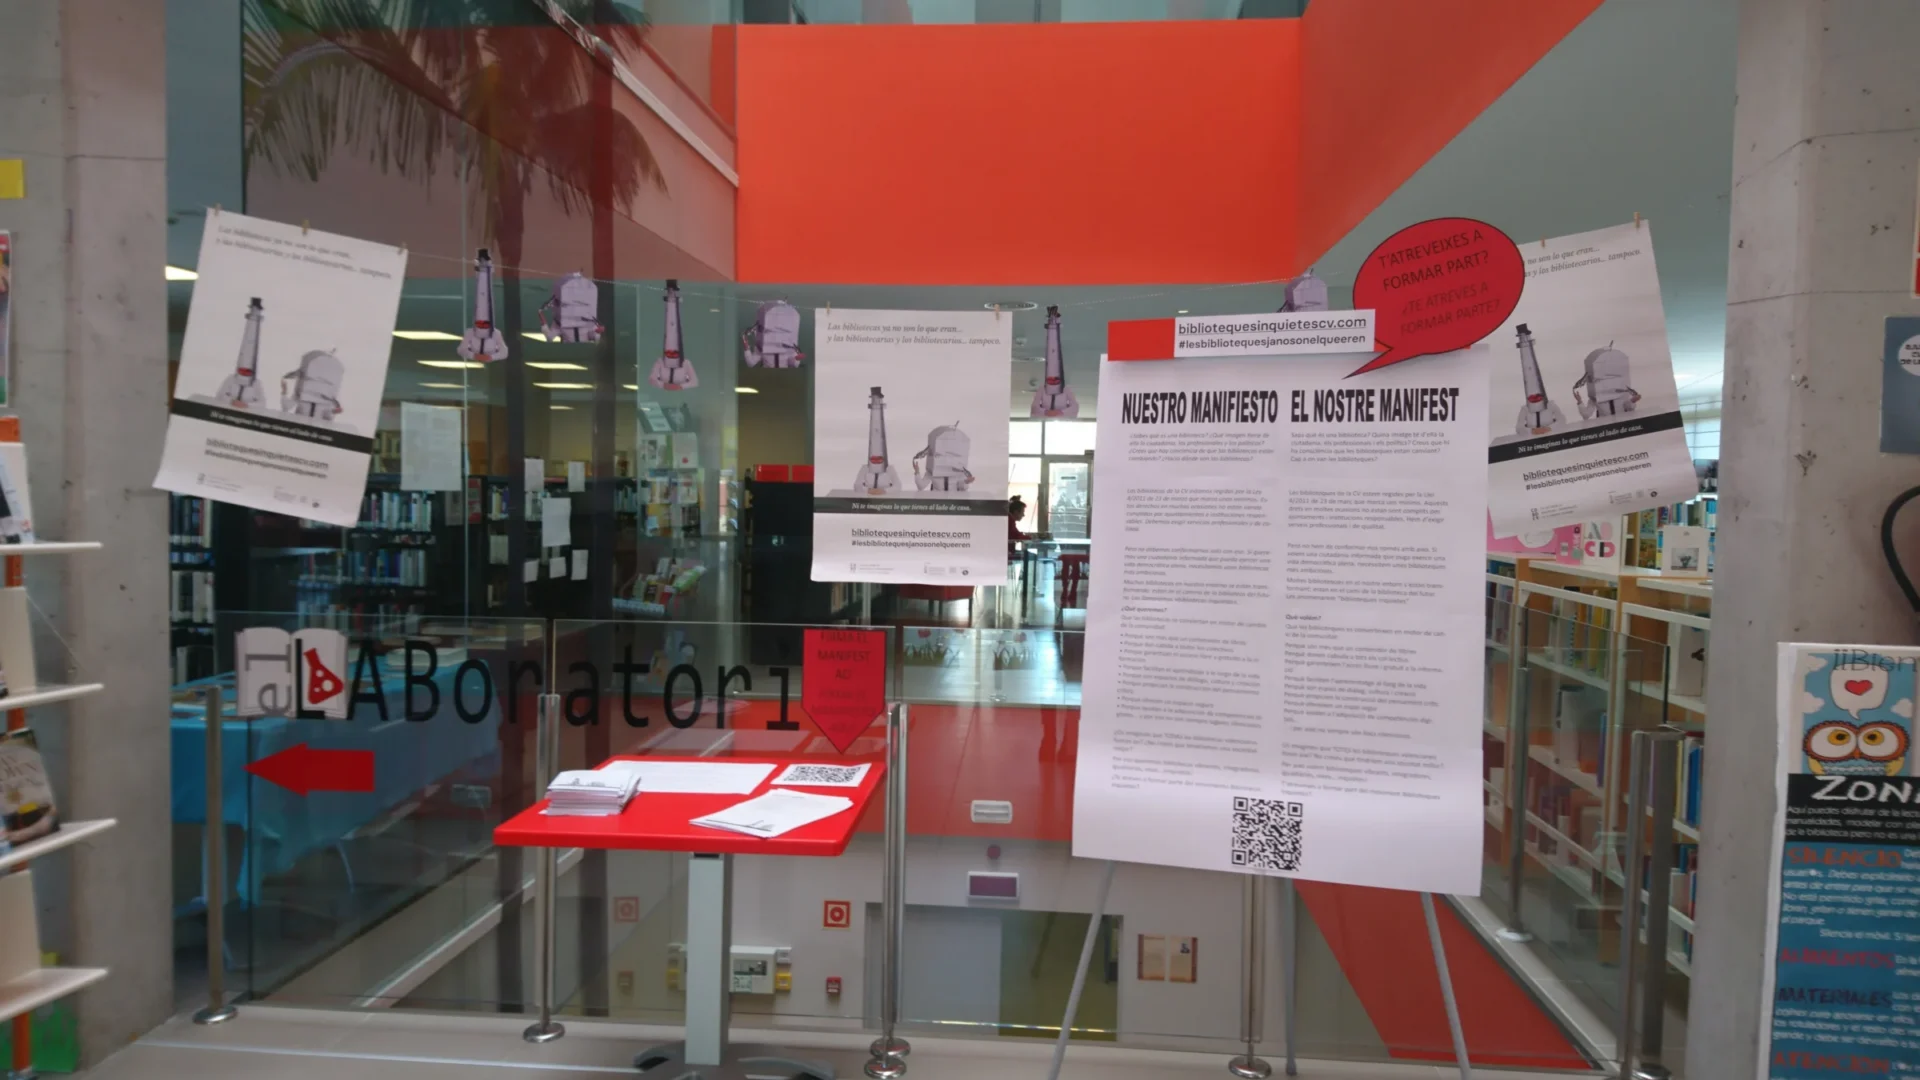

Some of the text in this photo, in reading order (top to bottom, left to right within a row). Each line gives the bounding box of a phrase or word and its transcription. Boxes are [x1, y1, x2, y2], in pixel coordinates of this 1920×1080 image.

[1378, 229, 1484, 269] T'ATREVEIXES A
[1561, 250, 1574, 260] que
[1383, 250, 1489, 292] FORMAR PART?
[1426, 284, 1477, 308] ATREVES
[1480, 281, 1488, 294] A
[827, 321, 841, 332] Las
[925, 326, 939, 336] que
[1178, 318, 1367, 335] bibliotequesinquietescv.com
[1400, 299, 1500, 336] FORMAR PARTE?
[1179, 334, 1366, 349] #lesbibliotequesjanosonelqueeren
[1121, 389, 1279, 424] NUESTRO MANIFIESTO
[1291, 387, 1460, 423] EL NOSTRE MANIFEST
[1522, 451, 1650, 481] bibliotequesinquietescv.com
[852, 529, 971, 540] bibliotequesinquietescv.com
[852, 540, 971, 550] #lesbibliotequesjanosonelqueeren
[818, 650, 871, 663] MANIFEST
[295, 637, 801, 732] LABoratori
[1810, 775, 1920, 804] ZON
[1787, 846, 1902, 868] SILENCIO
[1780, 947, 1896, 969] ALIMENTOS
[1779, 987, 1893, 1008] MATERIALES
